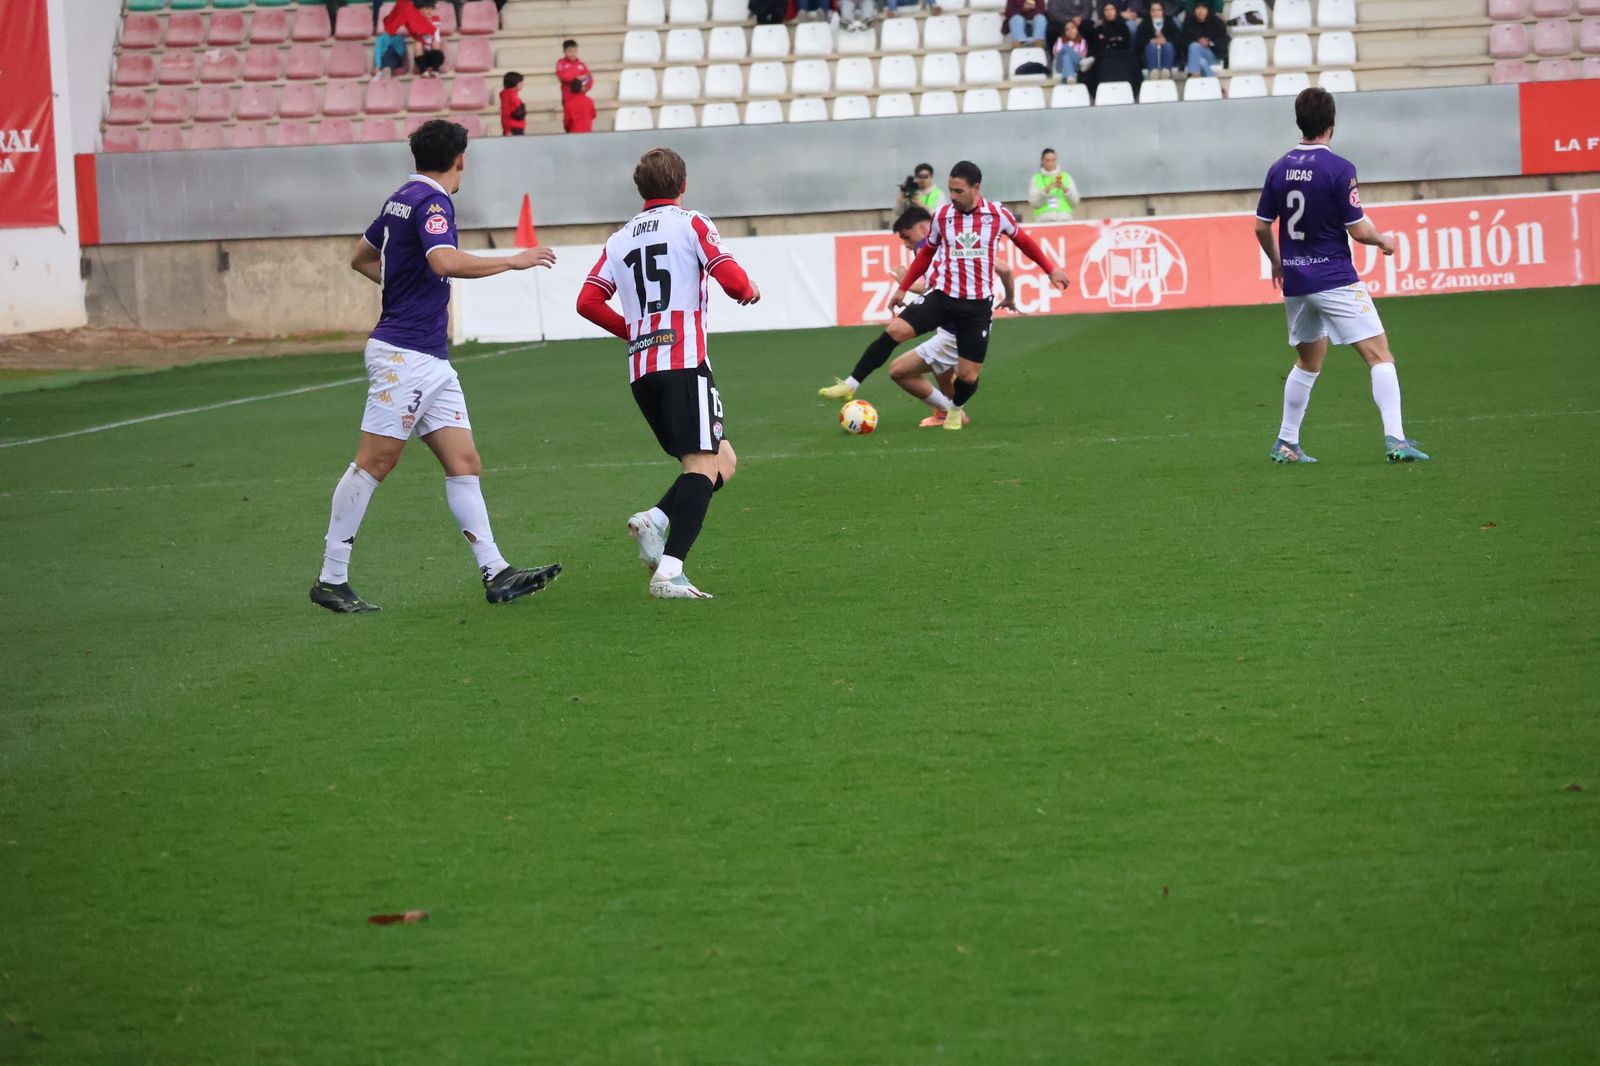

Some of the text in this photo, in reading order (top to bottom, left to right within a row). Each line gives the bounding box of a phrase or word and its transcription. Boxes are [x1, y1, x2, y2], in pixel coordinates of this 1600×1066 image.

[1554, 139, 1581, 152] LA
[1285, 169, 1313, 181] LUCAS
[1286, 190, 1306, 241] 2
[632, 219, 660, 238] LOREN
[622, 242, 672, 319] 15
[1401, 273, 1427, 291] de
[1431, 271, 1516, 291] Zamora
[408, 389, 423, 414] 3
